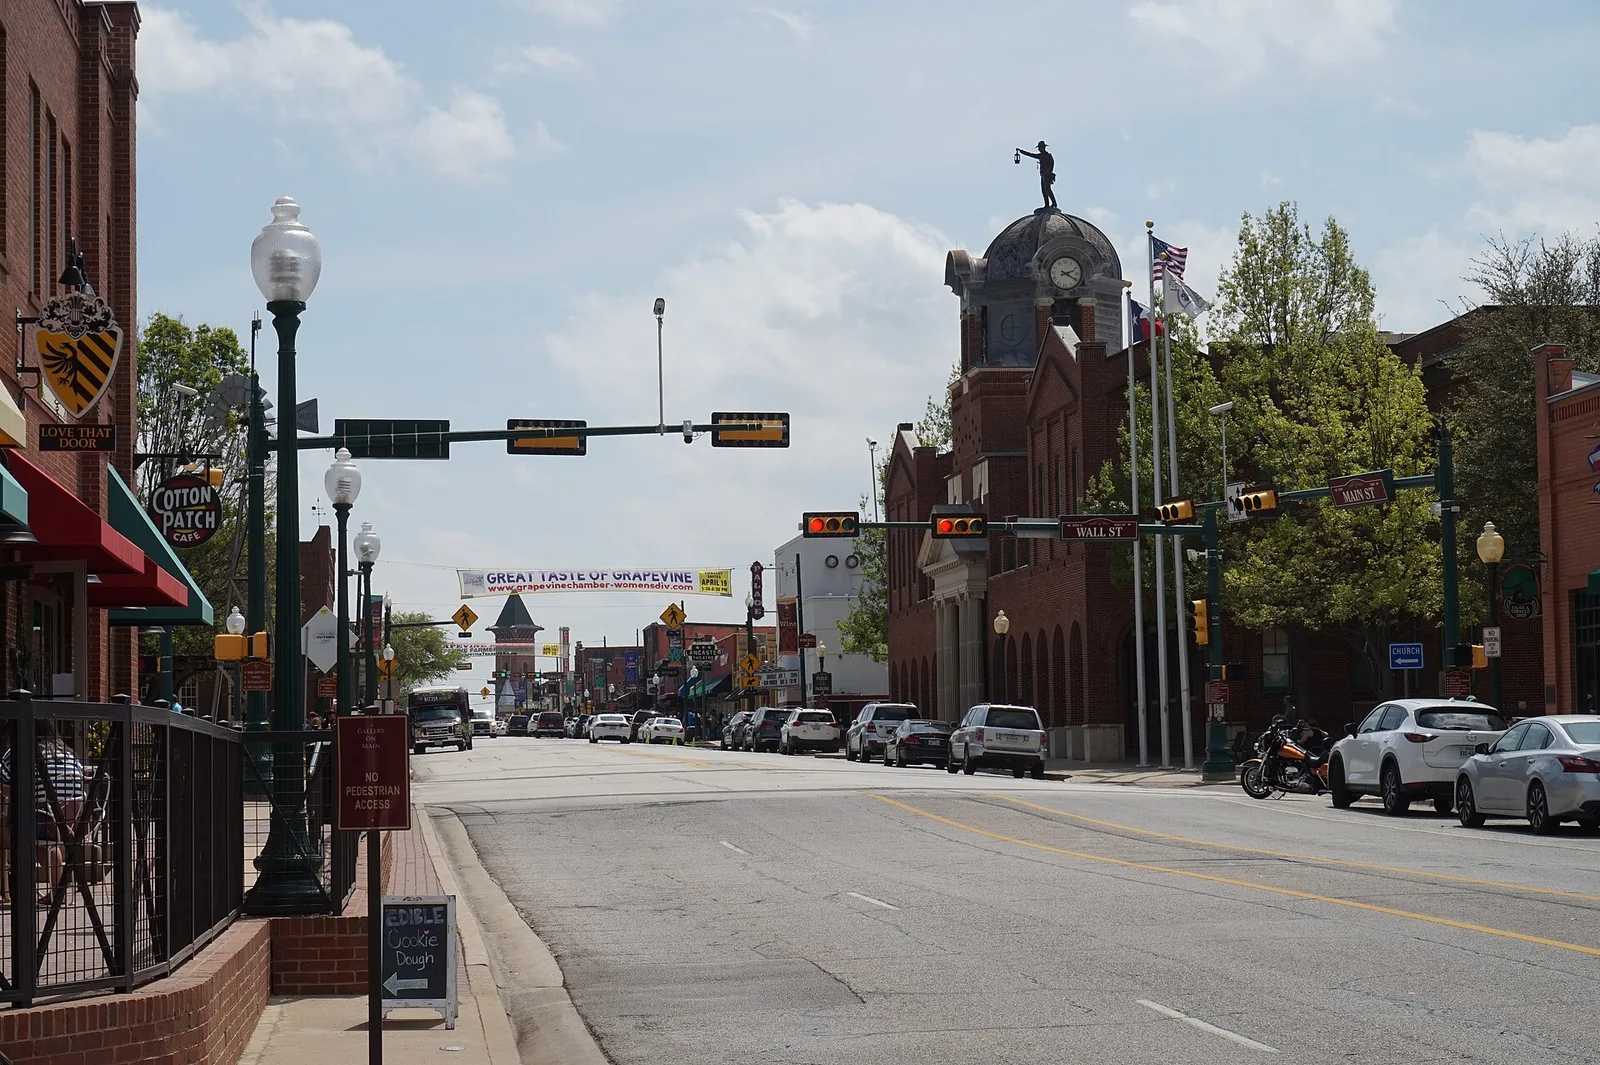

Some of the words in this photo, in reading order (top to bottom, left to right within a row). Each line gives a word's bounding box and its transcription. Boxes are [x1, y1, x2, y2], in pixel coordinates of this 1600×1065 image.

[41, 427, 75, 438] LOVE
[78, 427, 113, 438] THAT
[59, 438, 98, 448] DOOR
[152, 485, 211, 514] COTTON
[1342, 489, 1364, 503] MAIN
[1364, 487, 1376, 500] ST
[163, 510, 216, 536] PATCH
[173, 531, 201, 542] CAFE
[1076, 527, 1106, 538] WALL
[1108, 526, 1123, 537] ST
[487, 571, 535, 584] GREAT
[541, 570, 586, 582] TASTE
[589, 570, 609, 581] OF
[612, 570, 693, 583] GRAPEVINE
[721, 579, 728, 587] 19
[488, 581, 694, 592] www.grapevinechamber-womensdiv.com
[753, 566, 763, 615] PALACE
[1392, 647, 1420, 655] CHURCH
[365, 772, 379, 782] NO
[346, 785, 400, 797] PEDESTRIAN
[355, 799, 391, 810] ACCESS
[385, 906, 445, 927] EDIBLE
[388, 928, 439, 949] Cookie
[396, 950, 434, 971] Dough
